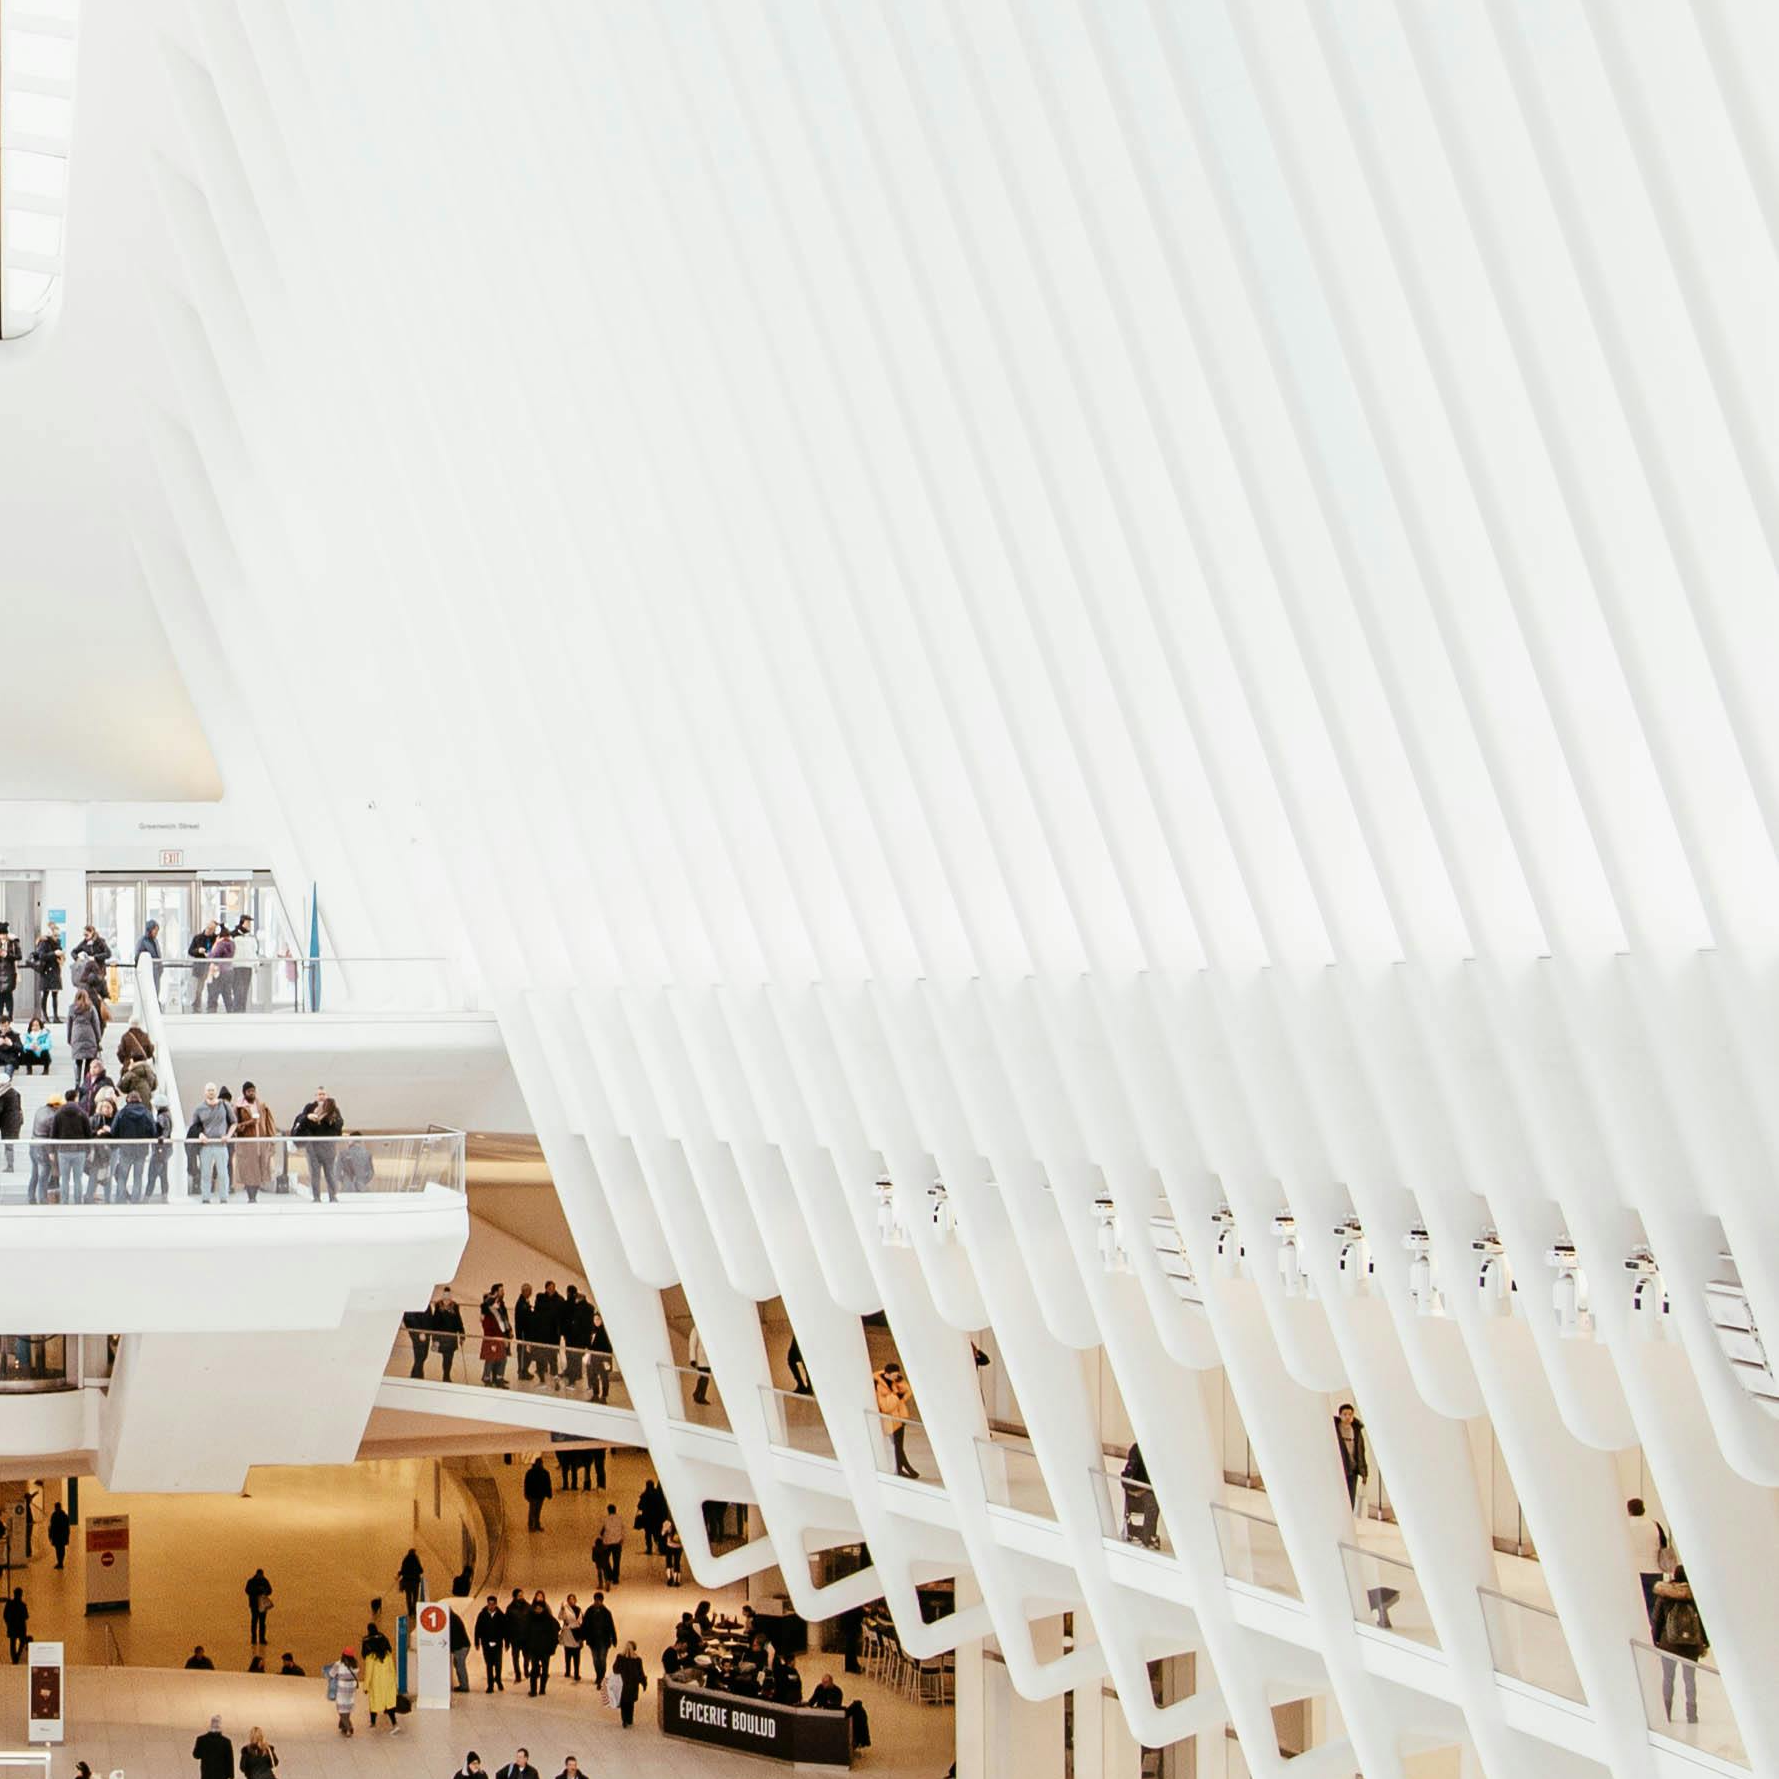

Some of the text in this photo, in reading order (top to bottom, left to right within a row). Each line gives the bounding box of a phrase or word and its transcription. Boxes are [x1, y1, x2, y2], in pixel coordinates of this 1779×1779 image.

[138, 822, 200, 830] Greenwich Street
[164, 851, 179, 865] EXIT
[428, 1611, 437, 1628] 1
[679, 1695, 776, 1739] ÉPICERIE BOULUD
